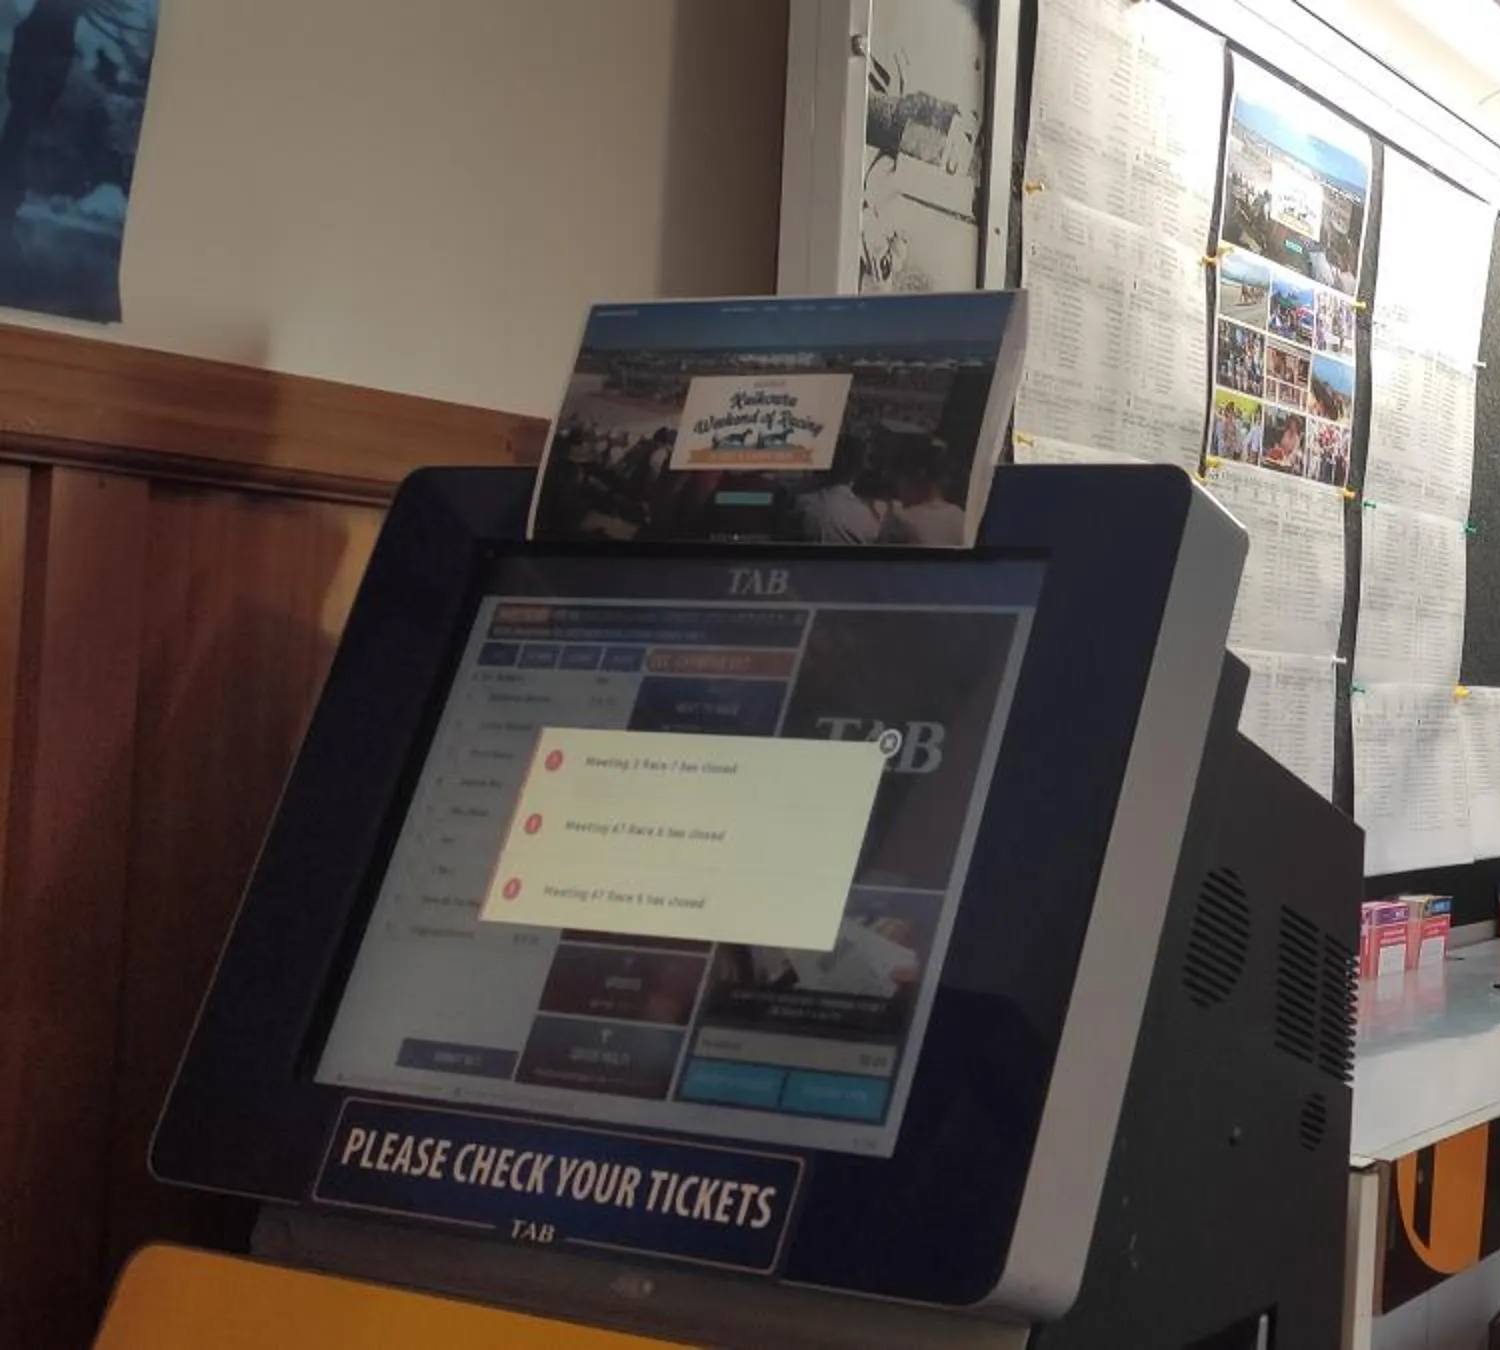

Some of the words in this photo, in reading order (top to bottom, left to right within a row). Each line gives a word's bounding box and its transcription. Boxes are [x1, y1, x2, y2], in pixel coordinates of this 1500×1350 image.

[726, 568, 789, 595] TAB
[585, 756, 629, 772] Meeting
[680, 760, 699, 772] has
[701, 761, 738, 774] closed
[565, 820, 609, 835] Meeting
[666, 826, 686, 838] has
[688, 828, 727, 841] closed
[544, 886, 588, 903] Meeting
[667, 896, 706, 909] closed
[342, 1127, 452, 1180] PLEASE
[453, 1142, 549, 1195] CHECK
[556, 1157, 642, 1210] YOUR
[645, 1170, 778, 1230] TICKETS
[510, 1219, 556, 1244] TAB
